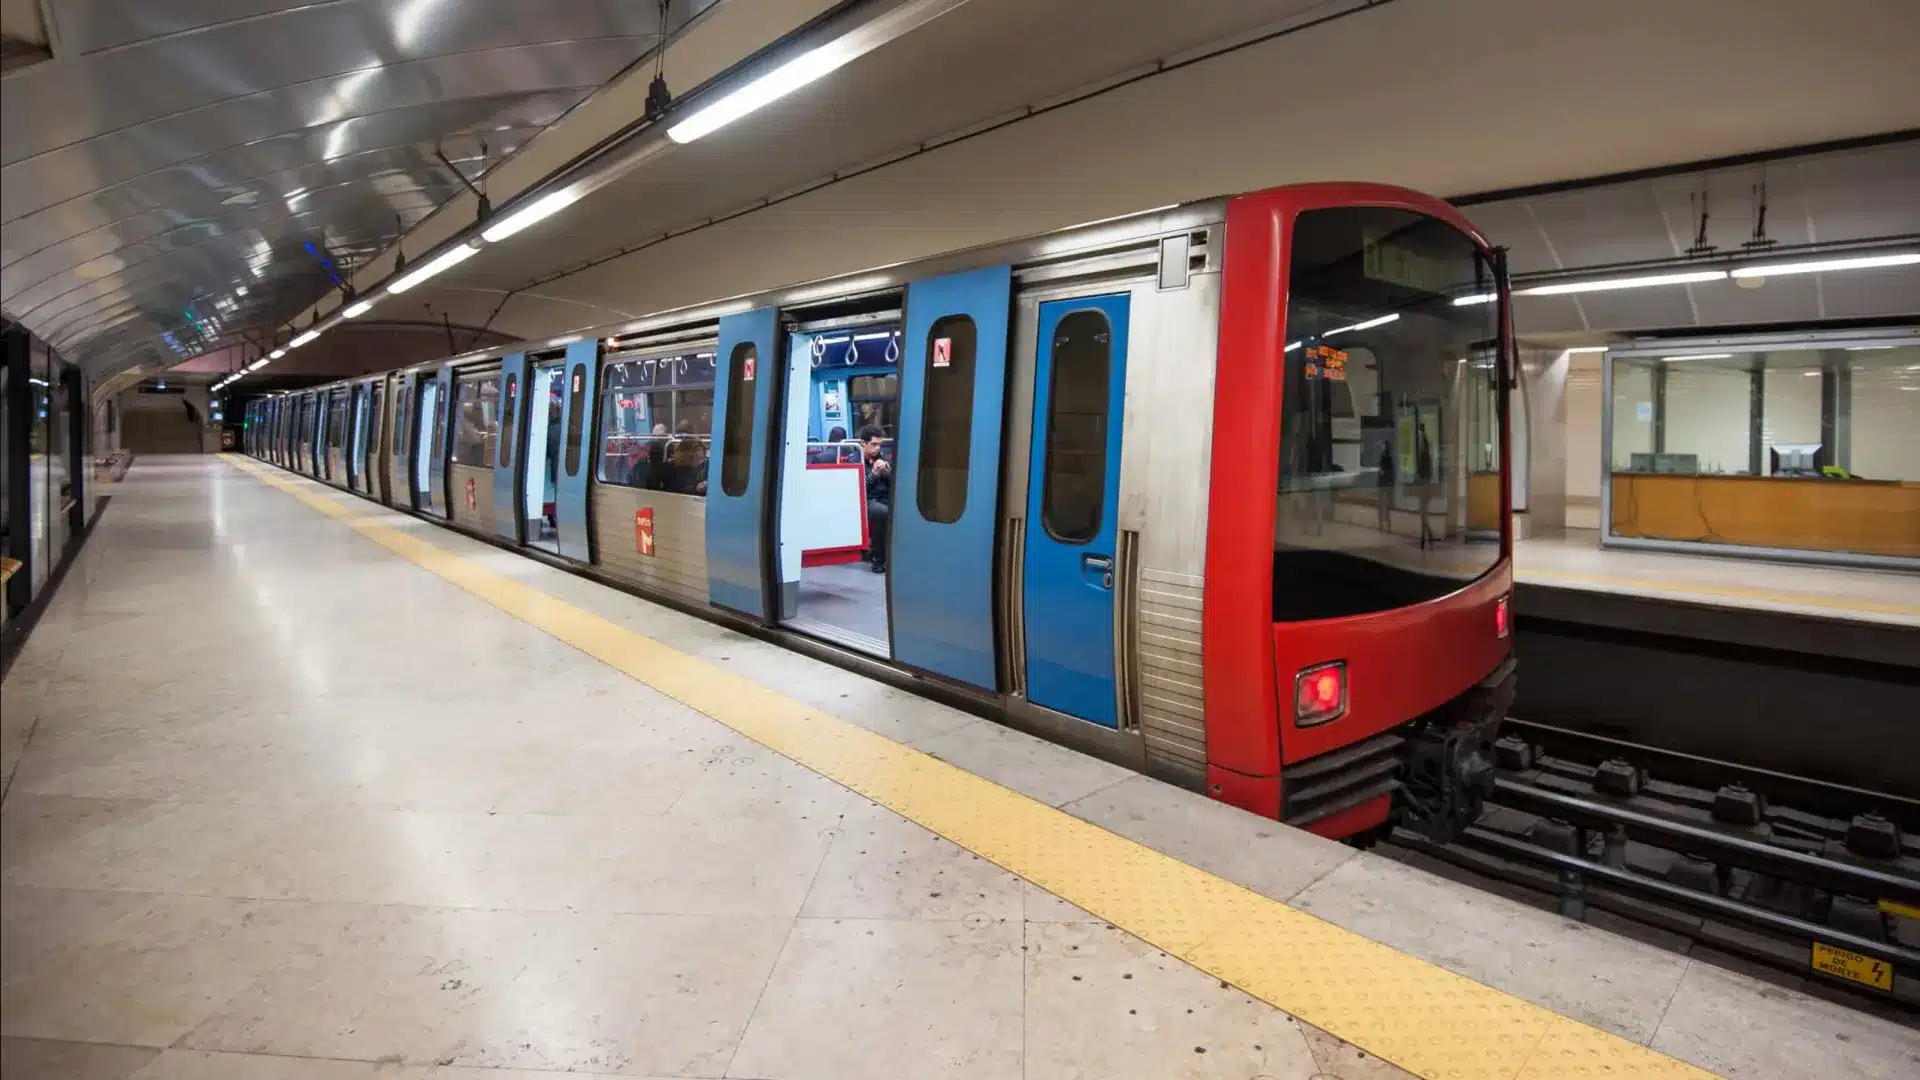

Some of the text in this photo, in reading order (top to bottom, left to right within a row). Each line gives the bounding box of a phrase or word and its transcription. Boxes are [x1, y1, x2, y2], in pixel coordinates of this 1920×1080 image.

[1820, 946, 1864, 963] PERIGO
[1832, 956, 1848, 968] DE
[1820, 961, 1861, 979] MORTE
